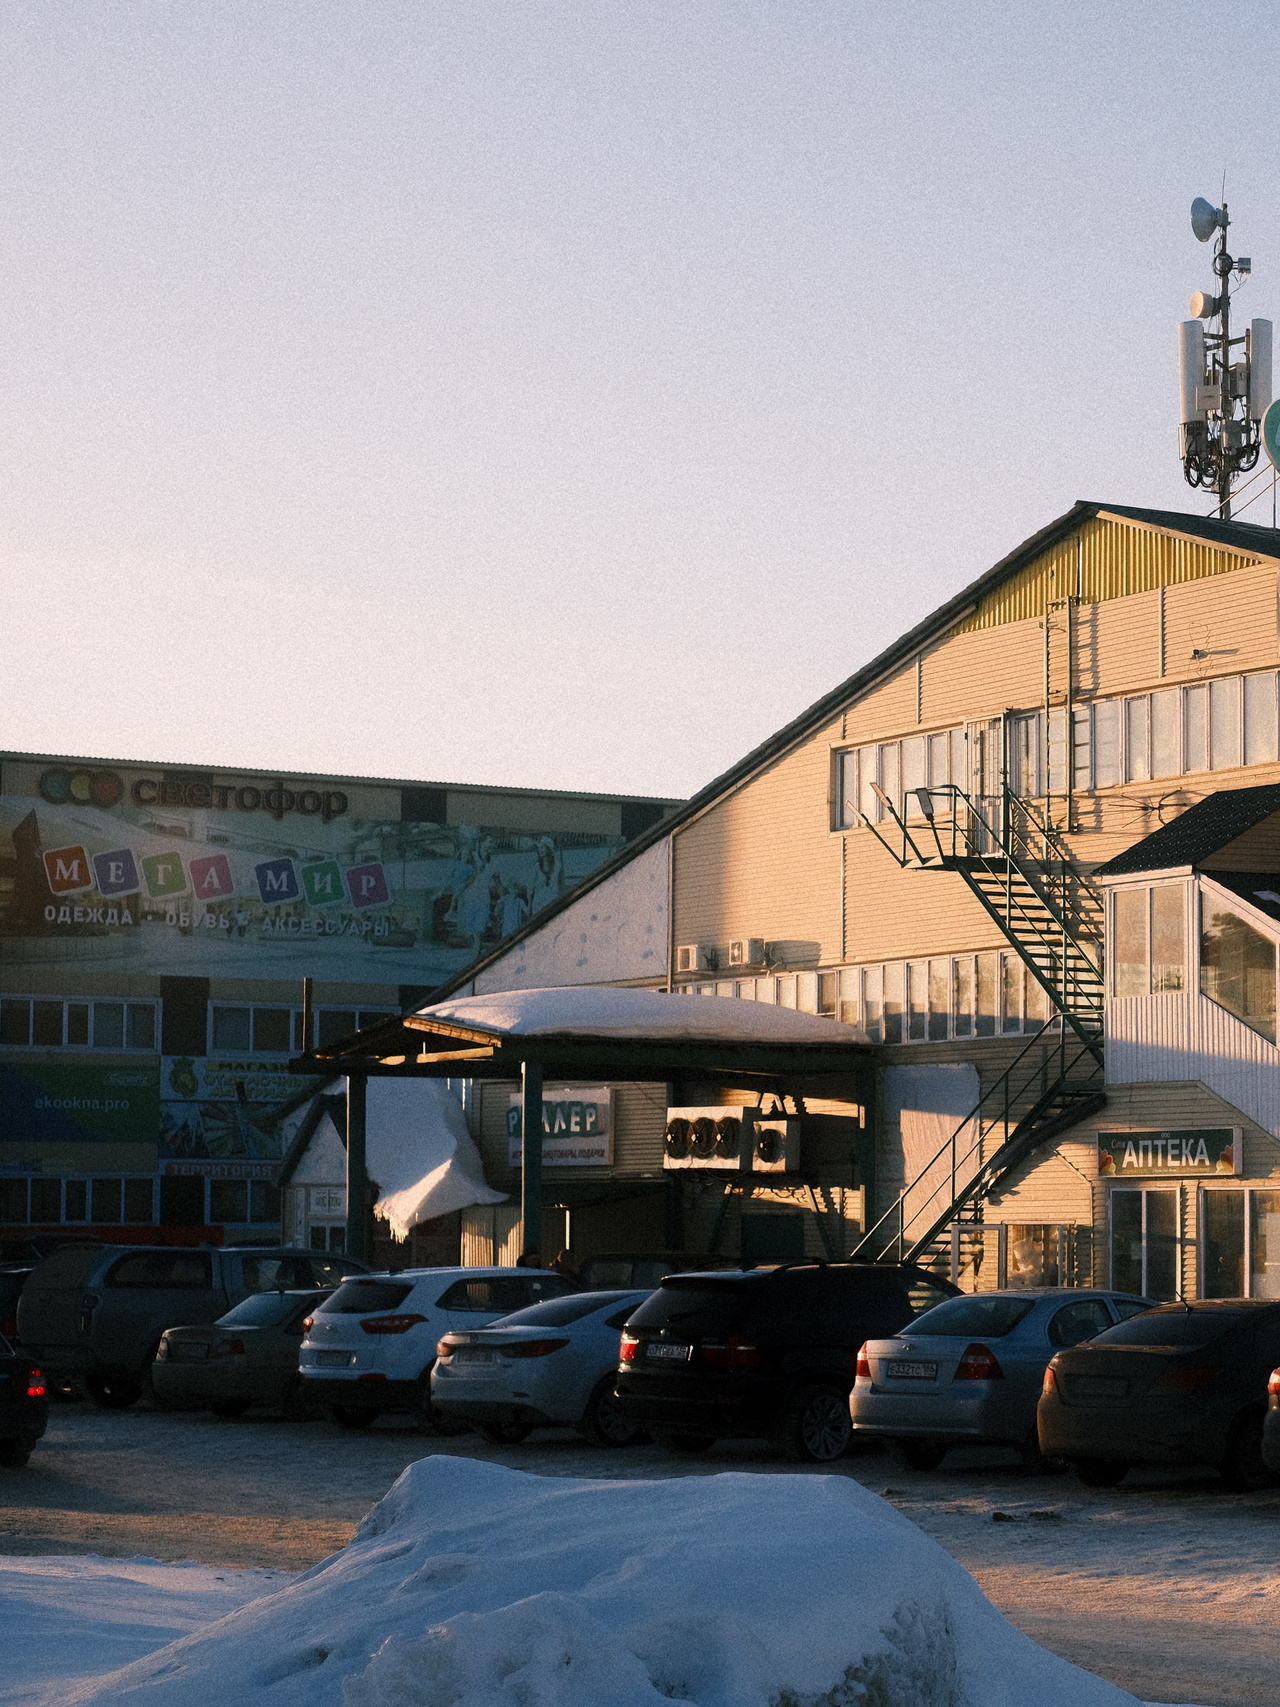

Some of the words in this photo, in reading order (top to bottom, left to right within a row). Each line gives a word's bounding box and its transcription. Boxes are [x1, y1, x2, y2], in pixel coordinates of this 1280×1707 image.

[132, 778, 349, 824] светофор
[43, 905, 134, 926] ОДЕЖДА
[164, 911, 231, 930] ОБУВЬ
[261, 915, 392, 937] АКСЕССУАРЫ
[218, 1062, 290, 1072] МАГАЗИ
[508, 1105, 597, 1134] РЛЛЕР
[1121, 1137, 1211, 1169] АПТЕКА
[171, 1163, 273, 1178] ТЕРРИТОРИЯ
